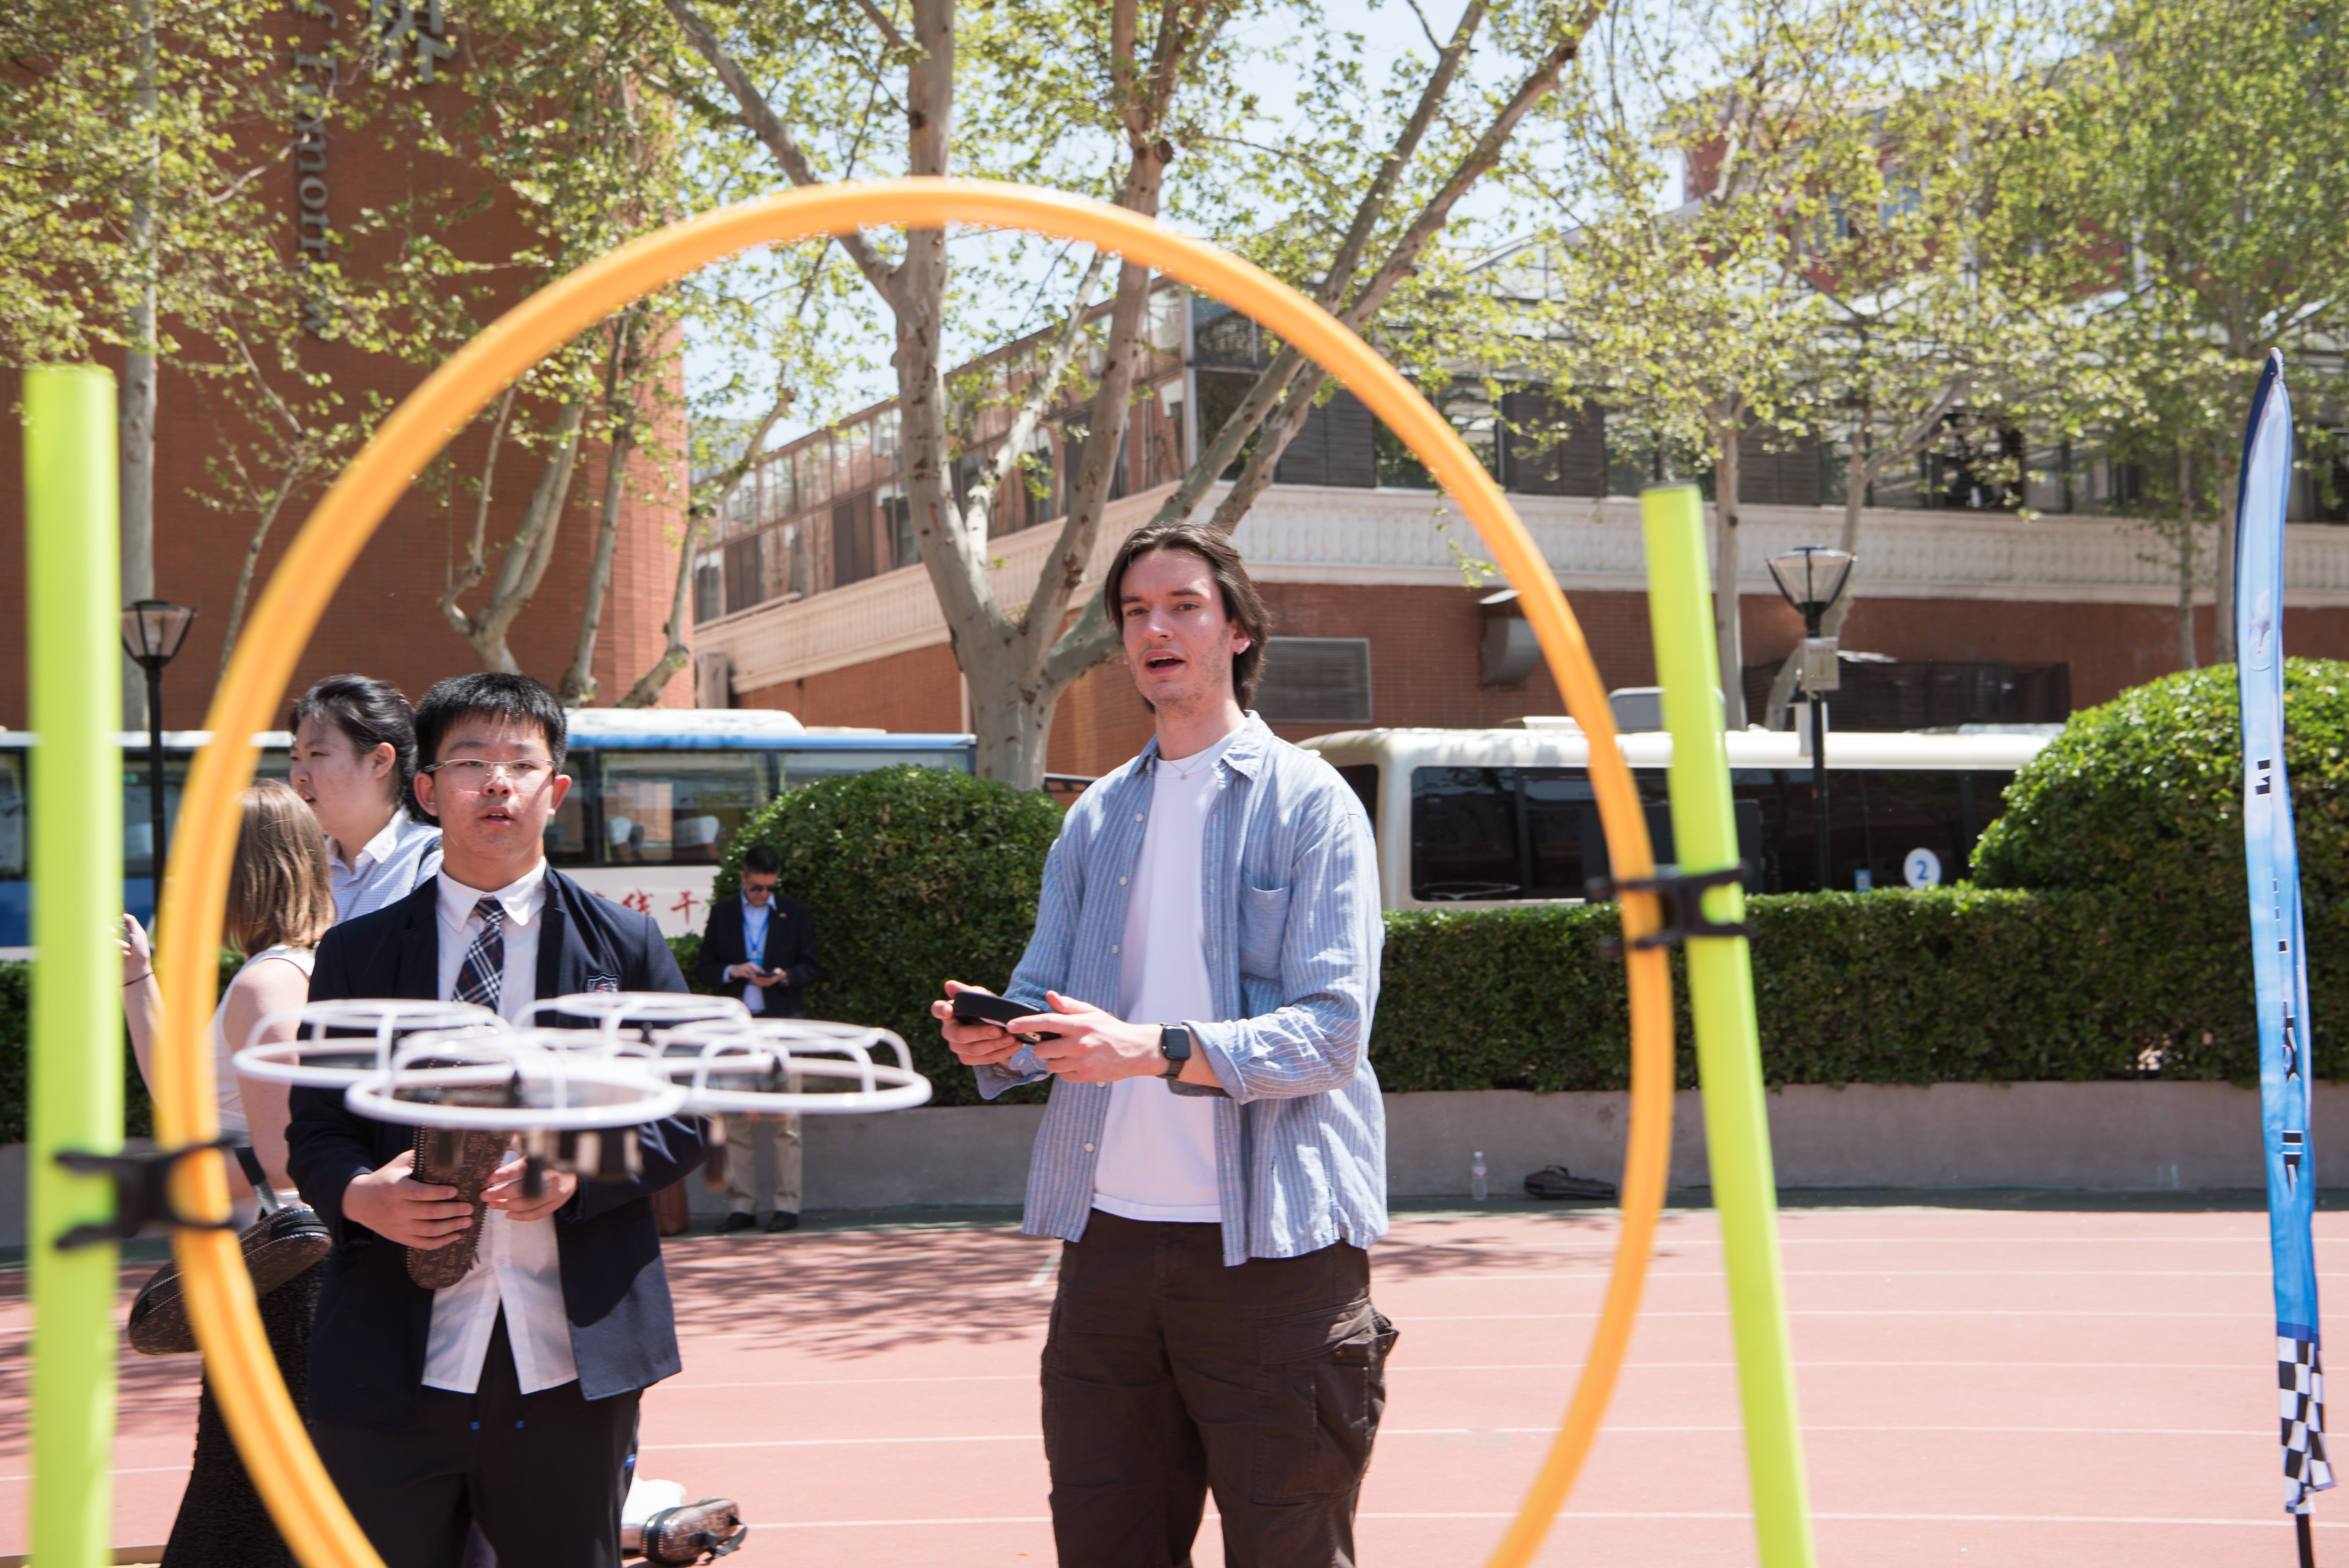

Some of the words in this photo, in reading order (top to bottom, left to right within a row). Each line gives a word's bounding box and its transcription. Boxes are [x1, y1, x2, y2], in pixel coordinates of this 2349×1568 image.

[294, 40, 338, 340] Tomorrw
[1916, 859, 1928, 880] 2
[595, 888, 699, 925] 线千
